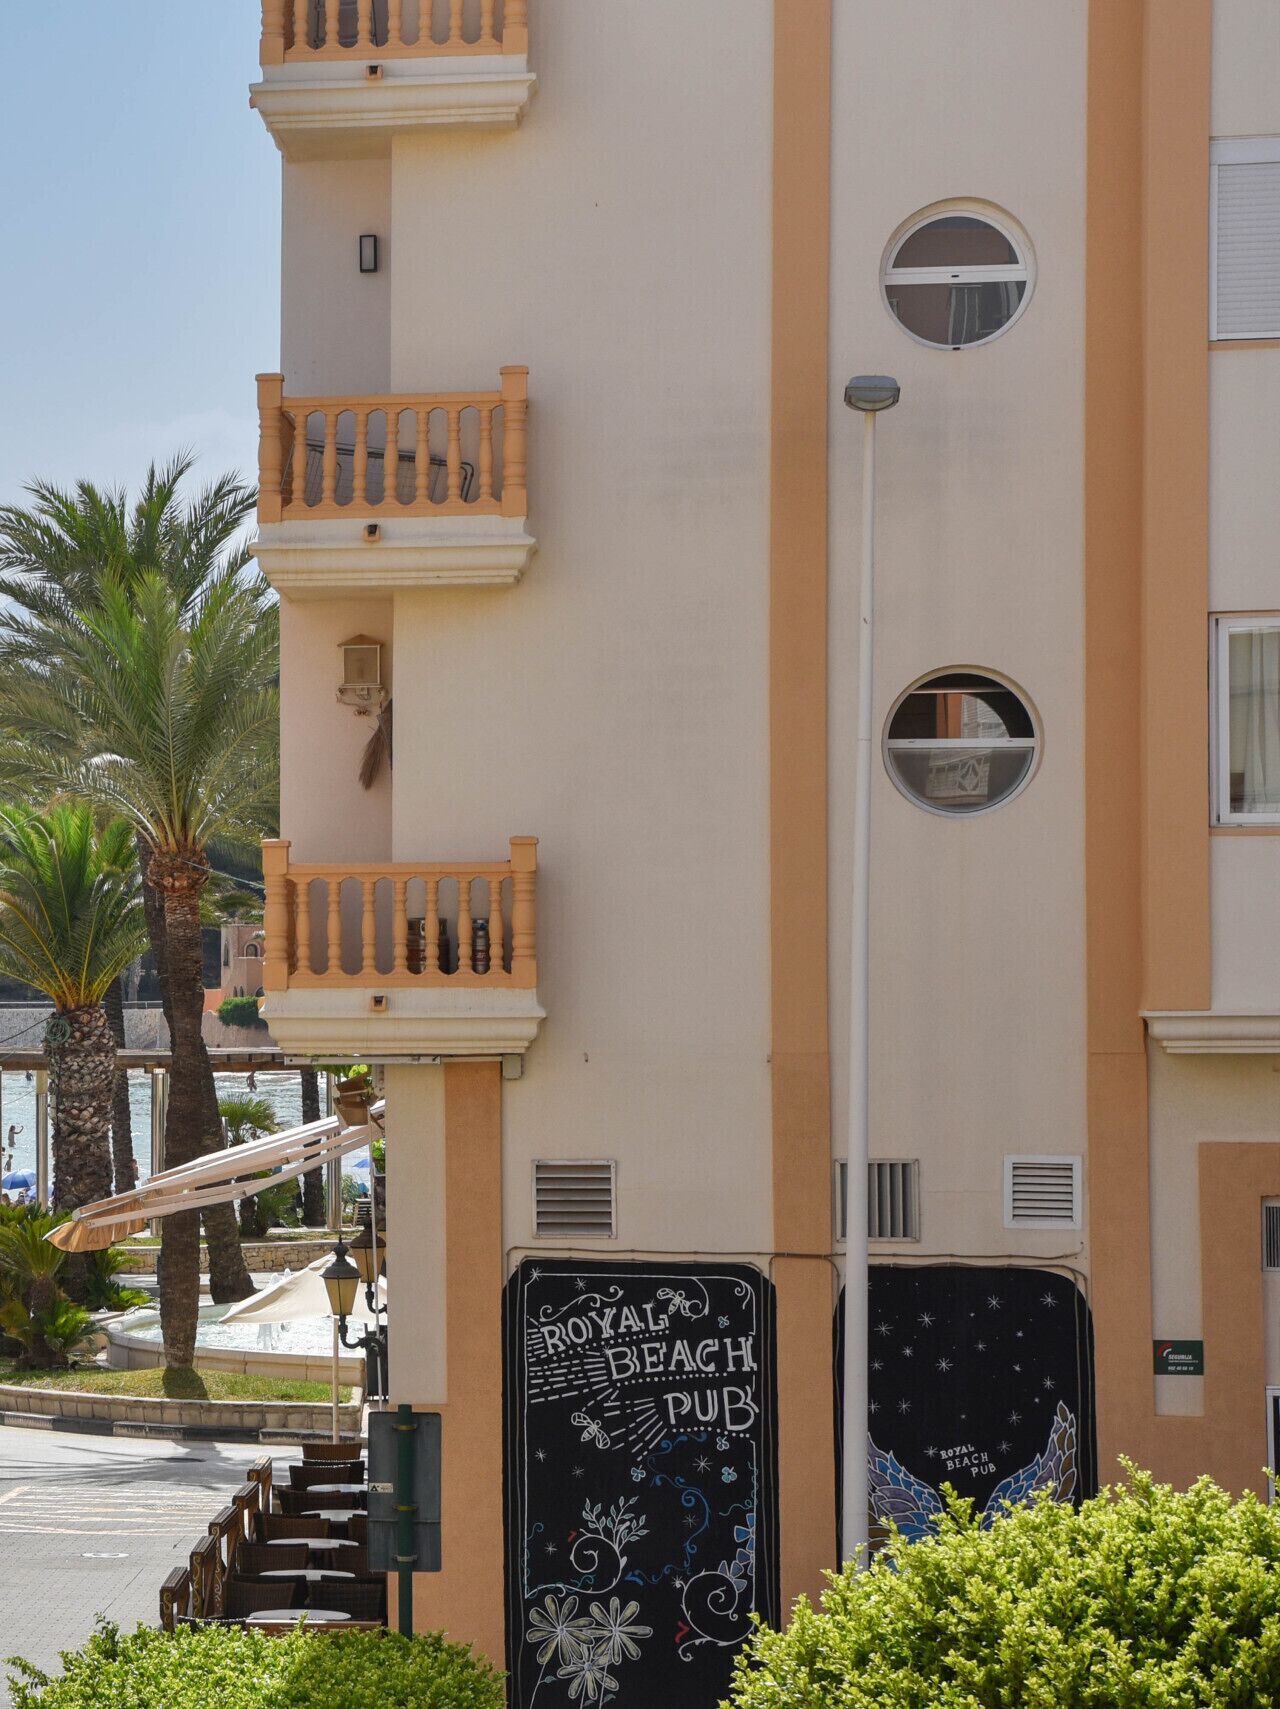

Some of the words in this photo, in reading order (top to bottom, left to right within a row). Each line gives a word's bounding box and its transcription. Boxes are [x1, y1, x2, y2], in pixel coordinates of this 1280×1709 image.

[540, 1303, 669, 1354] ROYAL
[607, 1336, 758, 1380] BEACH
[663, 1385, 760, 1431] PUB
[940, 1444, 975, 1459] ROYAL
[946, 1452, 989, 1471] BEACH
[970, 1462, 996, 1478] PUB
